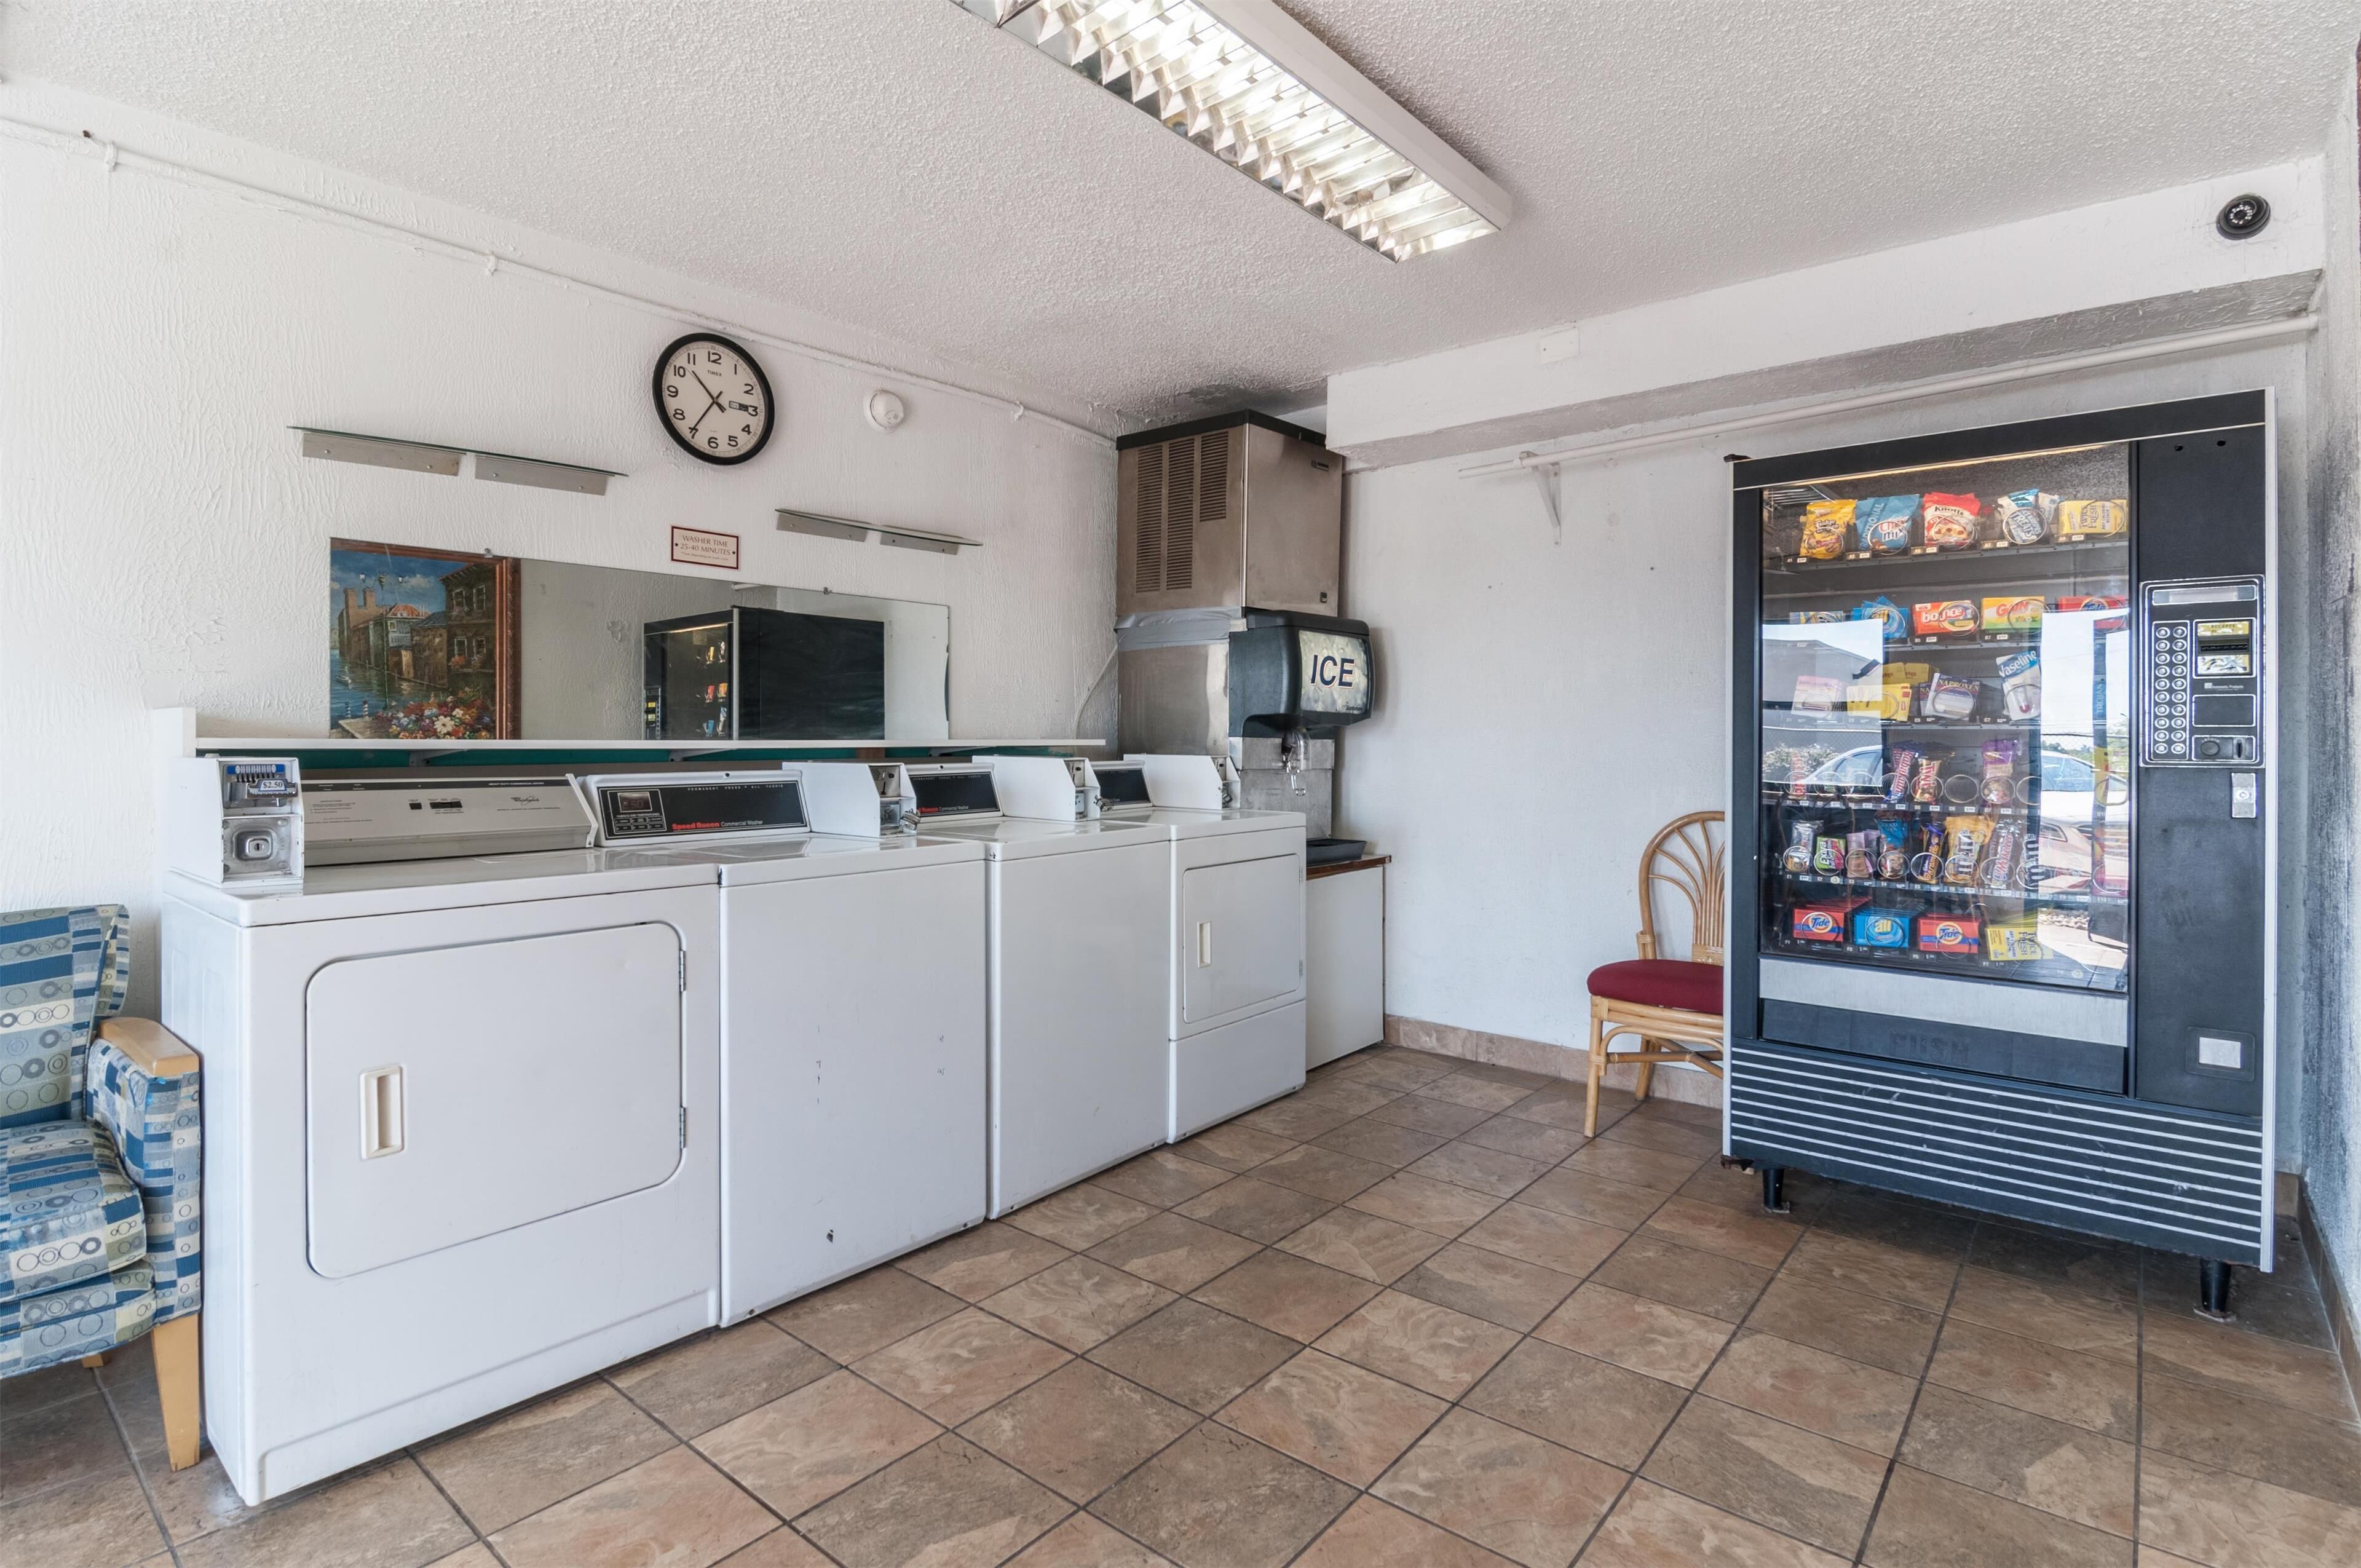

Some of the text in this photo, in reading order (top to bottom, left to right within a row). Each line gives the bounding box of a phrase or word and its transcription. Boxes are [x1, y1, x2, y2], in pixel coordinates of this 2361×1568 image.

[687, 352, 695, 365] 11
[708, 350, 722, 365] 12
[674, 365, 686, 378] 10
[734, 363, 737, 375] 1
[666, 385, 679, 398] 9
[743, 383, 754, 395] 2
[673, 408, 686, 421] 8
[748, 405, 759, 417] 3
[689, 427, 698, 439] 7
[741, 424, 752, 435] 4
[708, 437, 719, 449] 6
[727, 435, 738, 447] 5
[2088, 505, 2098, 529] FRESH
[1859, 504, 1884, 550] TRADITIONAL
[682, 535, 711, 545] WASHER
[680, 543, 730, 556] 25-40 MINUTES
[1921, 607, 1963, 623] bounce
[1311, 654, 1355, 688] ICE
[1999, 651, 2037, 678] Vaseline
[1938, 679, 1980, 691] NAPROXEN
[2095, 684, 2104, 713] TROJAN
[1811, 917, 1830, 928] Tide
[1875, 920, 1892, 932] all
[2018, 932, 2027, 956] FRESH
[1890, 1031, 1970, 1066] PUSH
